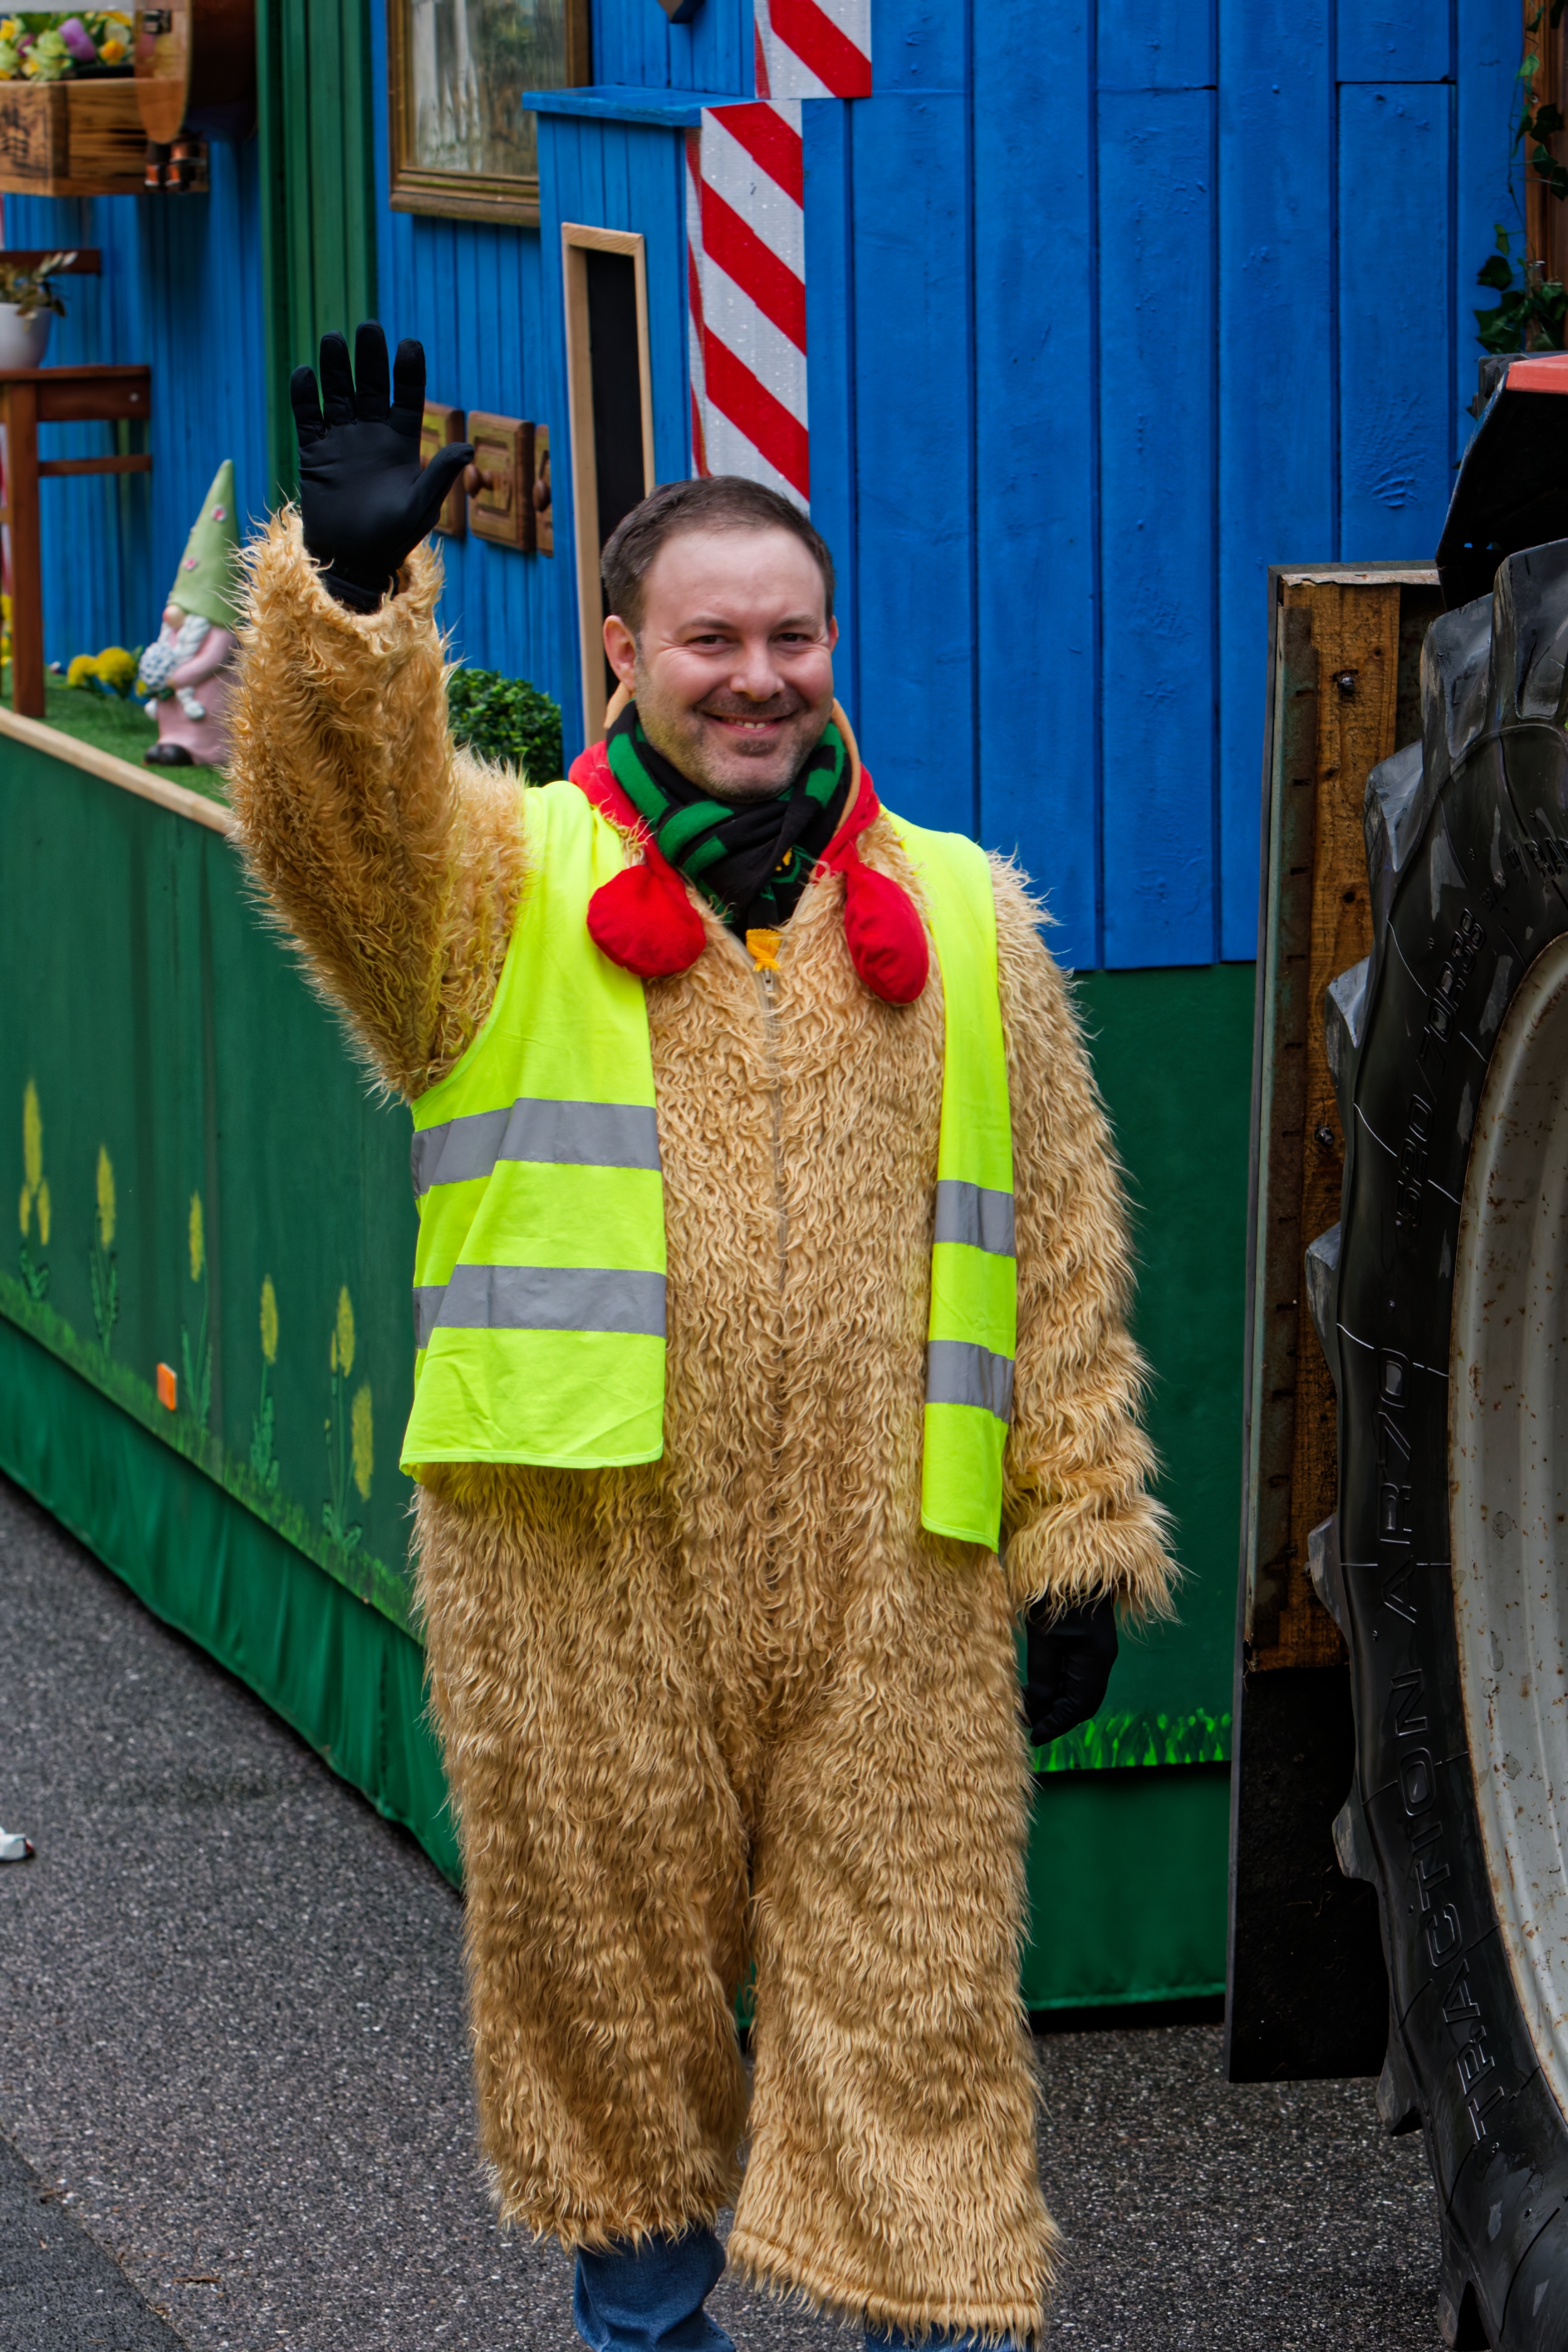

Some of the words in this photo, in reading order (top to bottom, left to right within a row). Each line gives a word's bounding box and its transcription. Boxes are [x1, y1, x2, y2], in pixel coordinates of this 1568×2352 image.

[1524, 837, 1568, 878] RA
[1378, 1348, 1417, 1625] AR70
[1390, 1669, 1504, 2143] TRACTION
